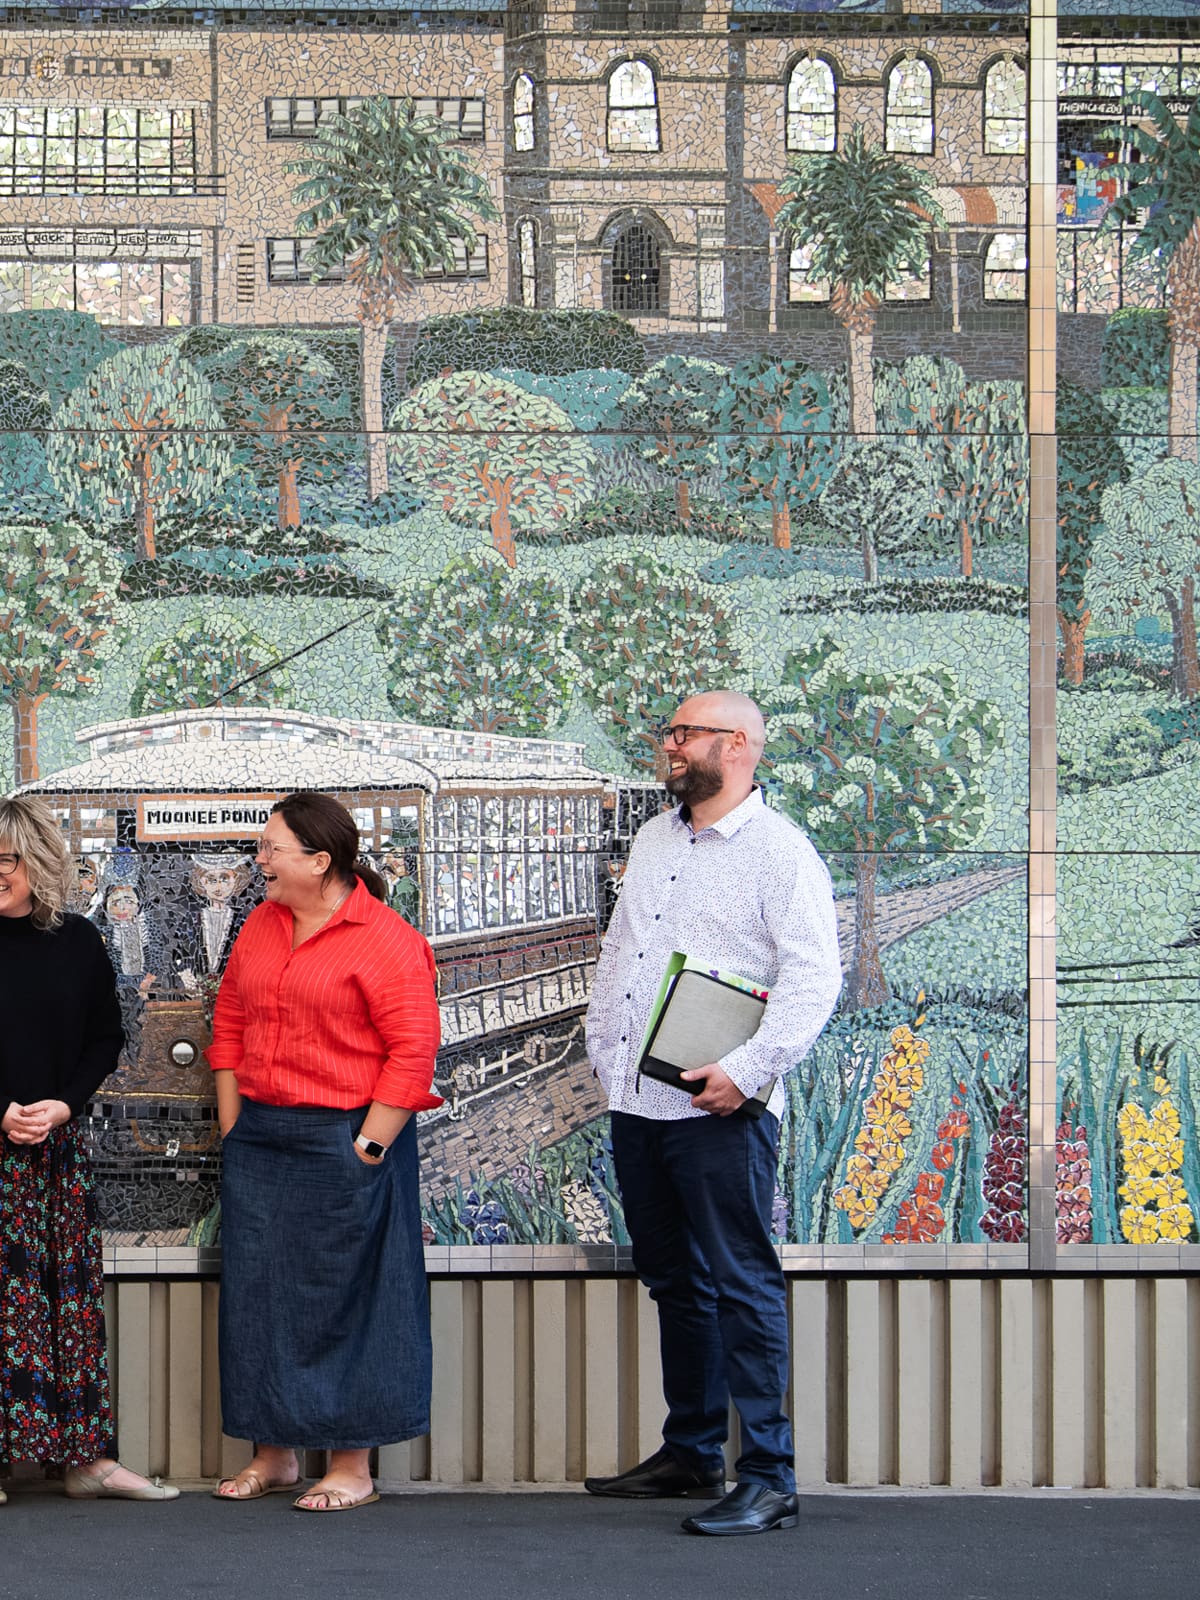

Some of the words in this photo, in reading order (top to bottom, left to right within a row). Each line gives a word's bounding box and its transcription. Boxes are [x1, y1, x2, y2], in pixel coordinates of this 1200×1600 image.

[73, 58, 161, 76] HALL
[147, 810, 218, 824] MOONEE
[221, 809, 273, 824] POND
